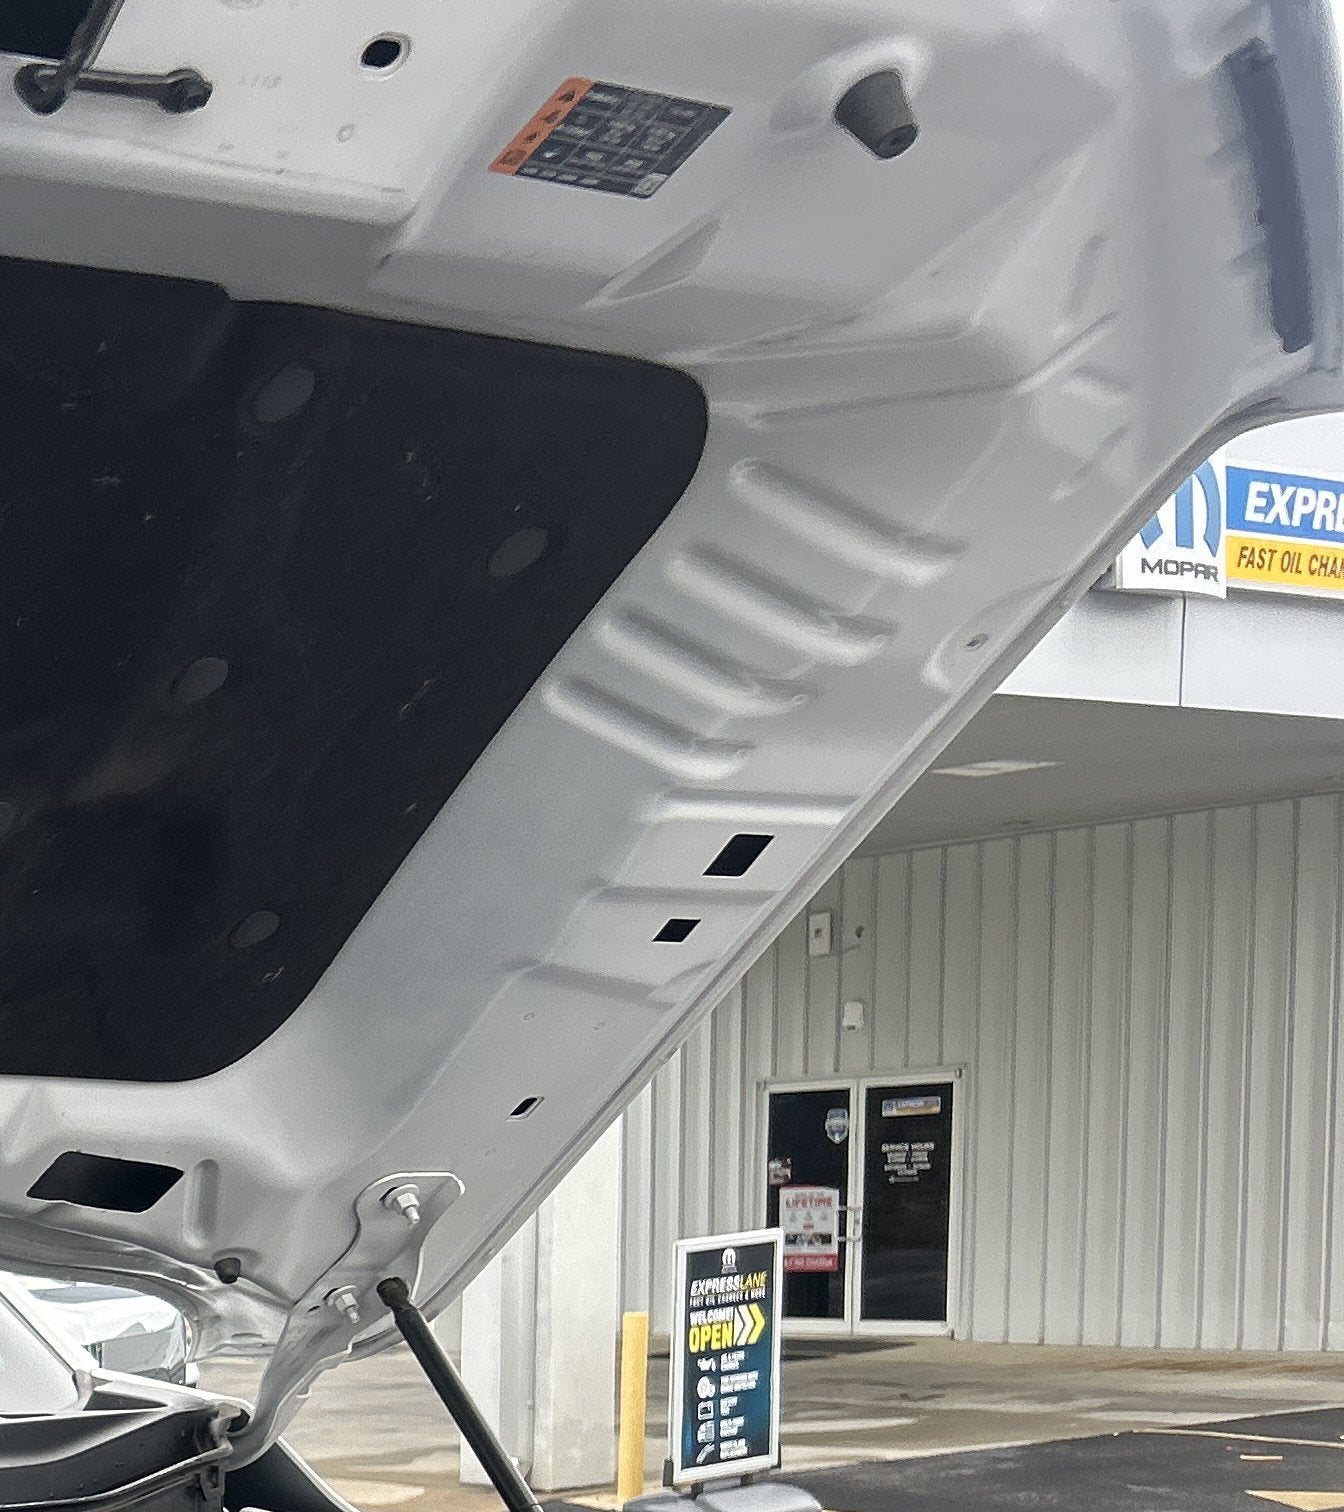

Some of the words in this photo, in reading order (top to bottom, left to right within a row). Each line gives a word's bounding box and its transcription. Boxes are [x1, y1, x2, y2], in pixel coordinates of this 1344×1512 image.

[1141, 557, 1219, 582] MOPAR
[1237, 545, 1278, 572] FAST
[1280, 550, 1303, 575] OIL
[688, 1321, 733, 1354] OPEN
